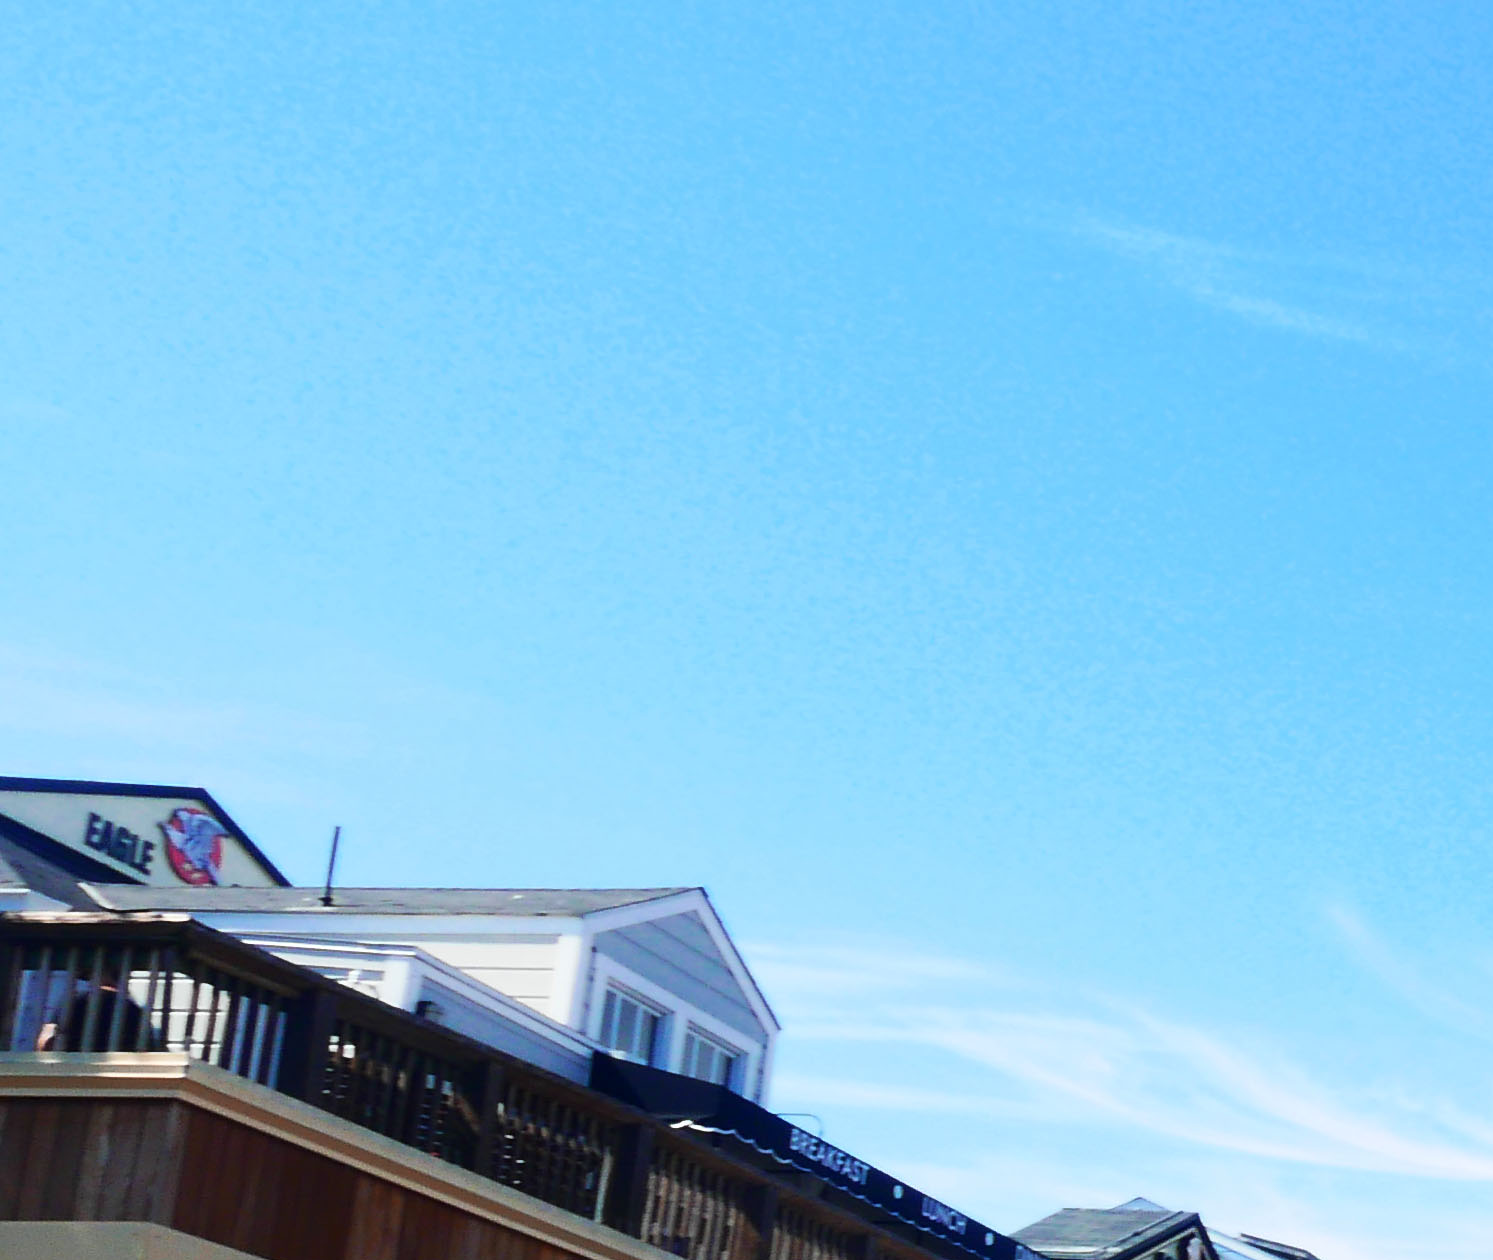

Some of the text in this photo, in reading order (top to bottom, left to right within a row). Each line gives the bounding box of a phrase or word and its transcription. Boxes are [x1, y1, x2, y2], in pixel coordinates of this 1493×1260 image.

[85, 811, 155, 876] EAGLE
[790, 1128, 870, 1186] BREAKFAST
[921, 1197, 967, 1236] LUNCH
